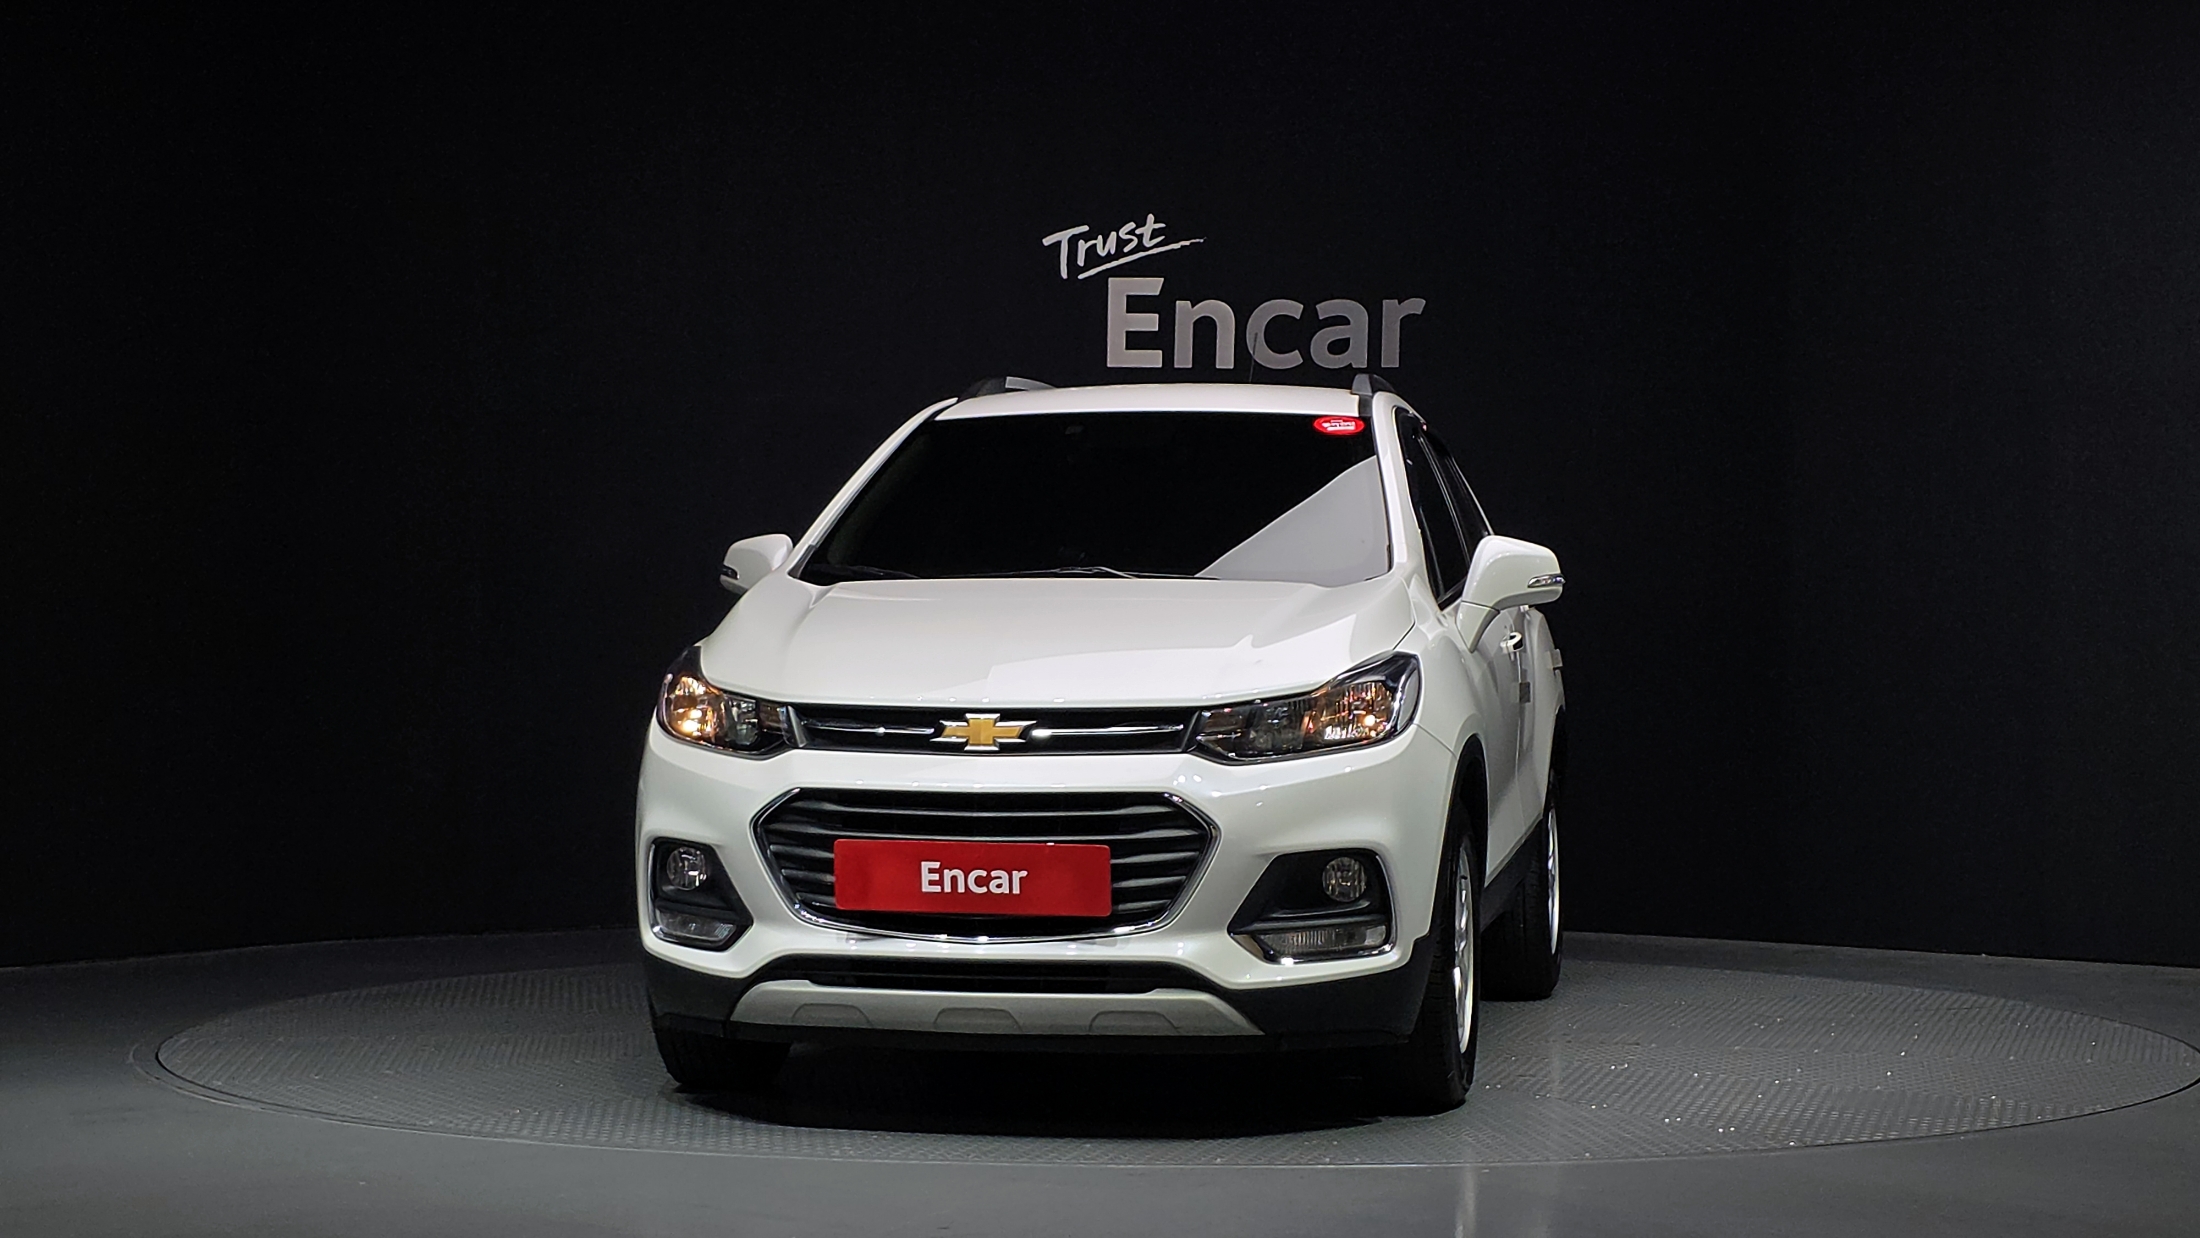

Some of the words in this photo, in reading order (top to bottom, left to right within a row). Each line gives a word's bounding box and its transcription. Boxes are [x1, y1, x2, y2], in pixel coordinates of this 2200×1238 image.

[1042, 213, 1167, 280] Trust
[1106, 277, 1427, 369] Encar
[920, 860, 1029, 895] Encar
